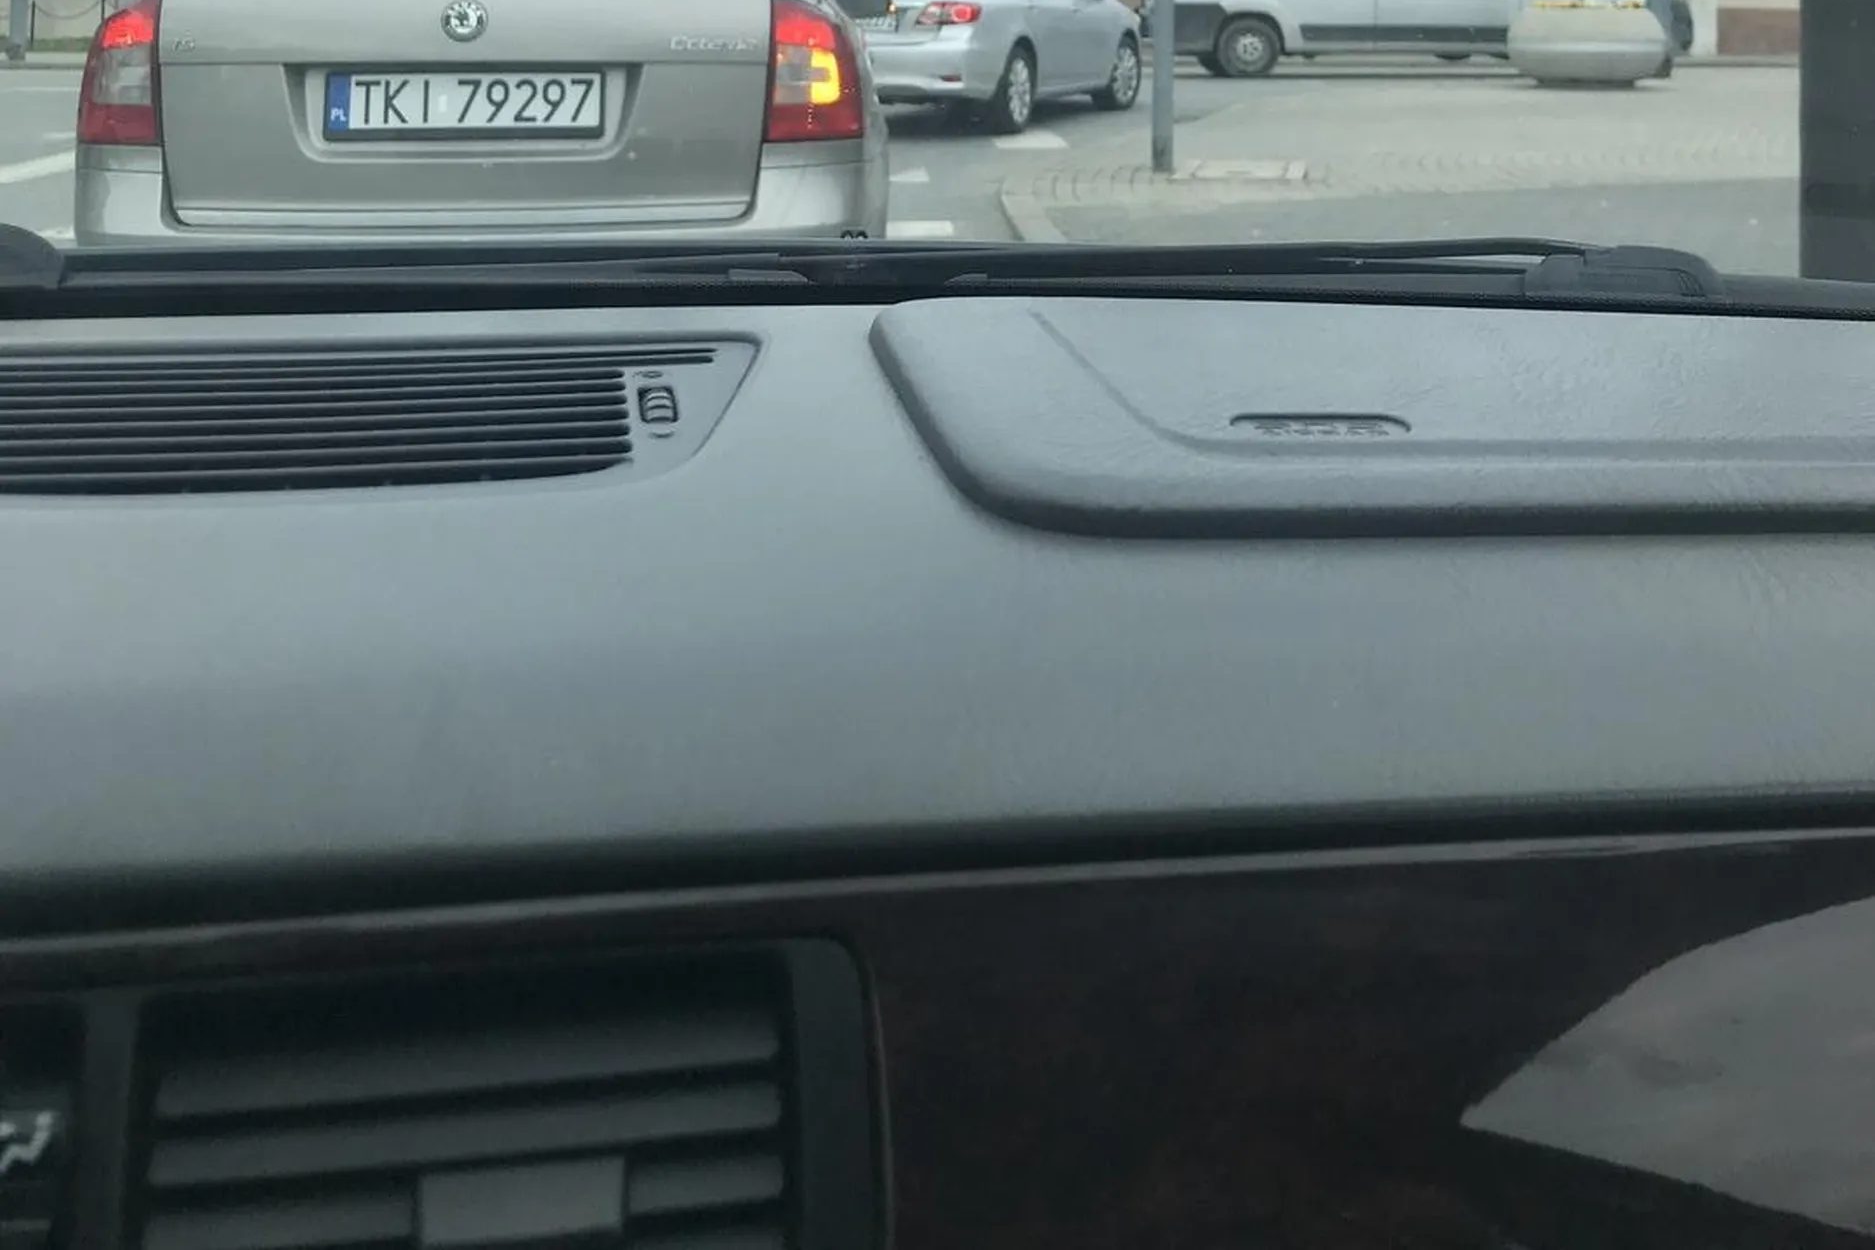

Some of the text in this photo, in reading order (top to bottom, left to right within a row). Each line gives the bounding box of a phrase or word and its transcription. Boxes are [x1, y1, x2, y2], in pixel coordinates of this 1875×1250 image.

[329, 108, 347, 122] PL
[355, 77, 595, 125] TKI 79297
